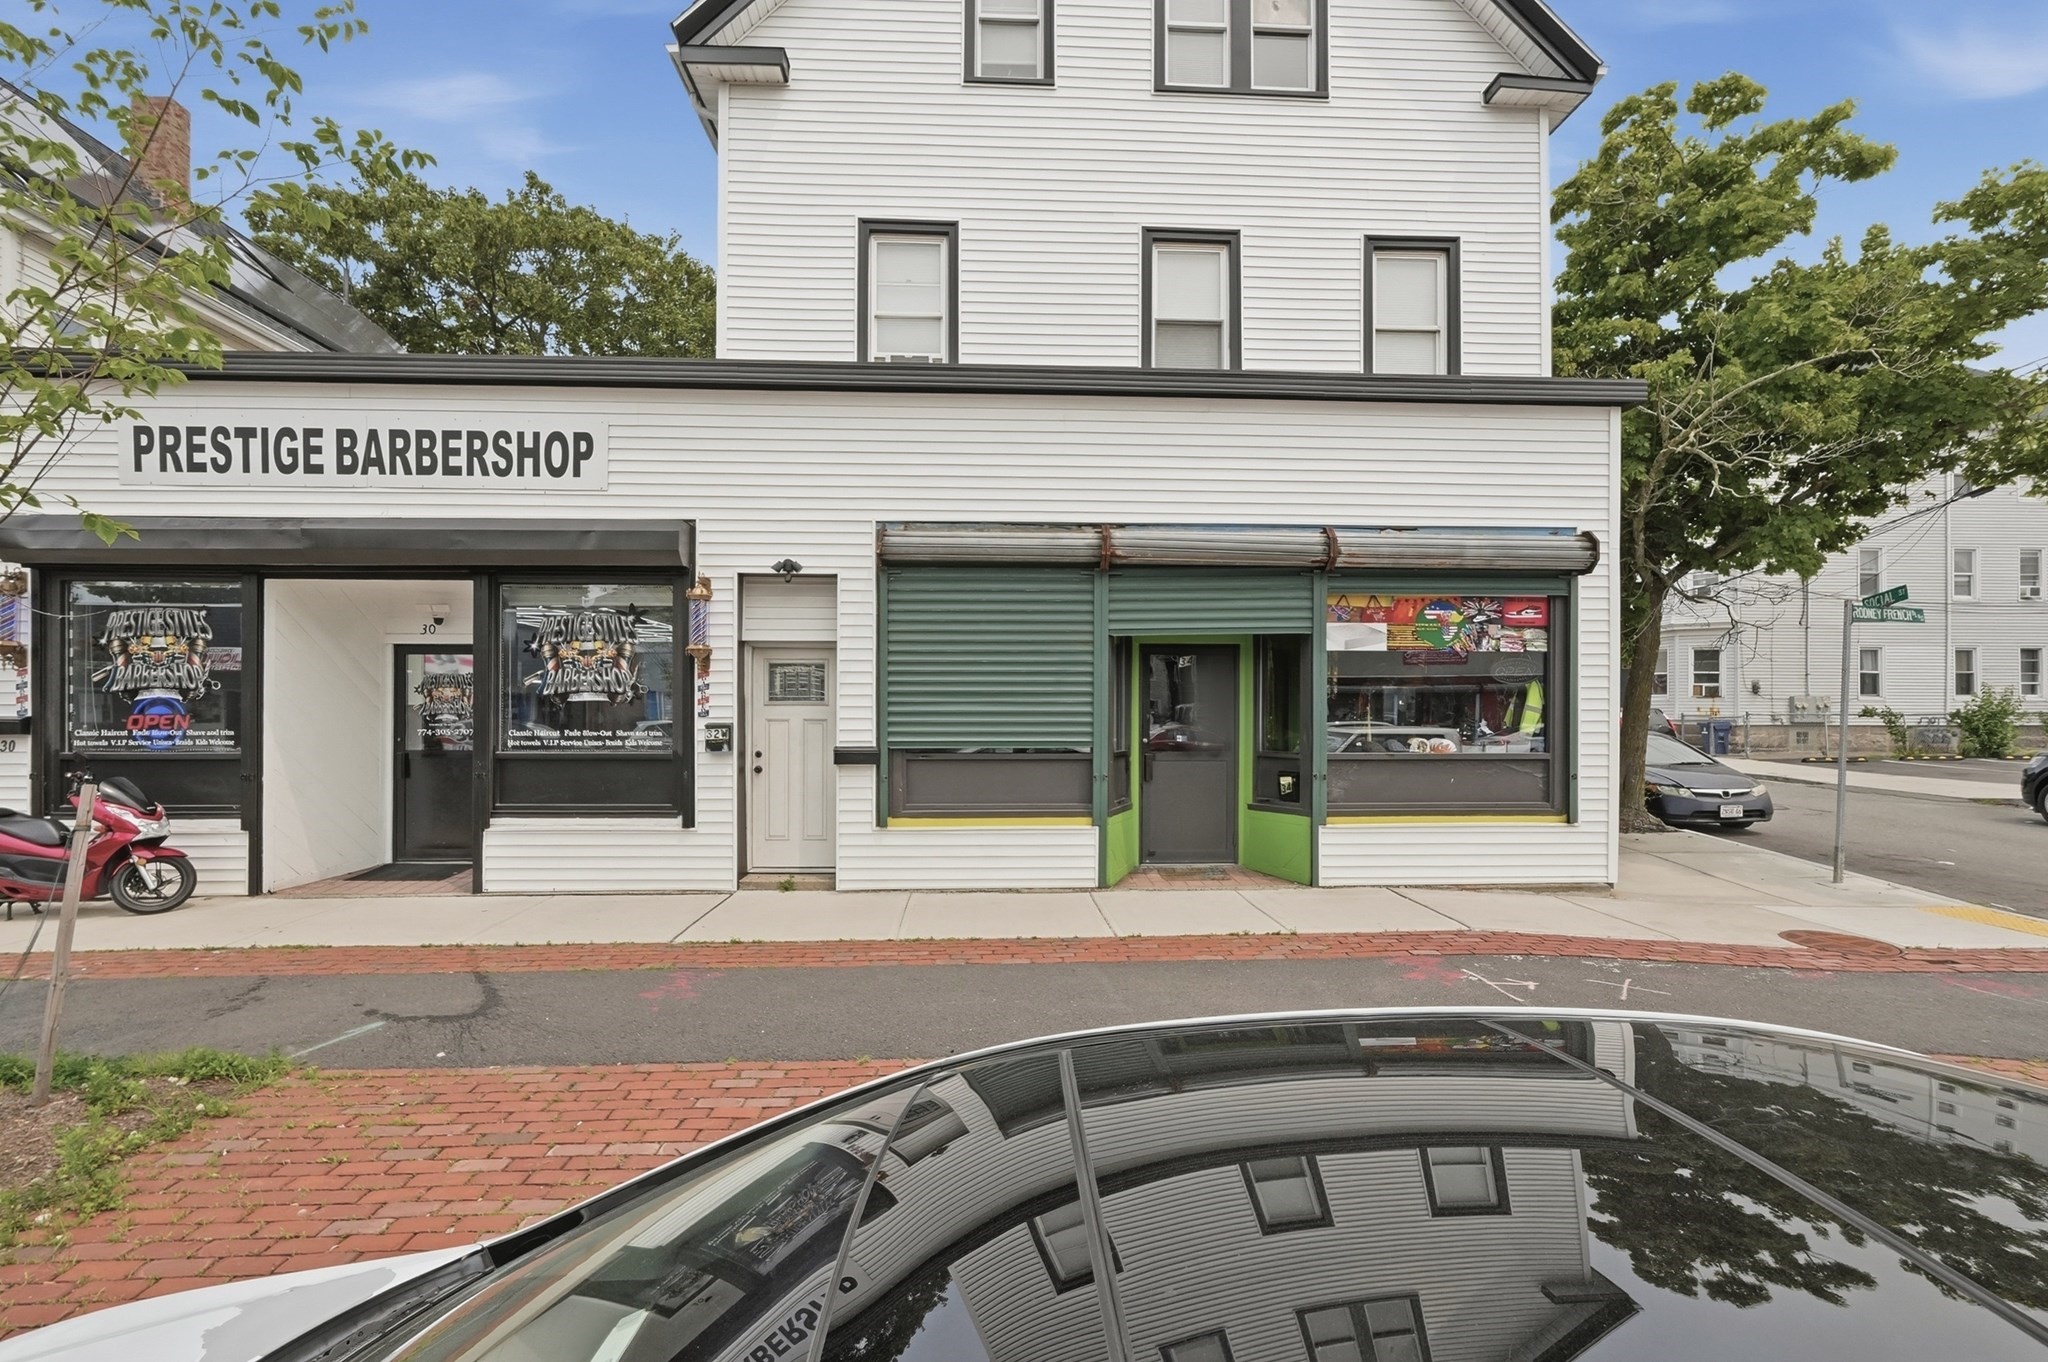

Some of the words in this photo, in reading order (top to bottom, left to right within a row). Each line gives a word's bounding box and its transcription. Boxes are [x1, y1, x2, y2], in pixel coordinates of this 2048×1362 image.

[132, 425, 324, 474] PRESTIGE
[335, 428, 594, 477] BARBERSHOP
[1864, 591, 1896, 608] SOCIAL
[1898, 588, 1906, 597] ST
[1853, 607, 1882, 620] RODNEY
[1883, 608, 1913, 621] FRENCH
[104, 608, 164, 639] PRESTIGE
[164, 608, 213, 640] STYLES
[420, 623, 436, 635] 30
[537, 613, 594, 644] PRESTIGE
[594, 613, 639, 645] STYLES
[1179, 656, 1194, 667] 34
[111, 662, 204, 693] BARBERSHOP
[542, 667, 632, 695] BARBERSHOP
[126, 714, 191, 730] OPEN
[74, 729, 99, 737] Classic
[508, 729, 533, 737] Classic
[534, 729, 560, 737] Haircut
[564, 729, 582, 737] Fade
[0, 740, 16, 753] 30
[73, 739, 86, 747] Hot
[87, 739, 109, 747] towels
[195, 738, 209, 746] Kids
[209, 738, 235, 746] Welcome
[507, 739, 520, 748] Hot
[520, 739, 542, 747] towels
[560, 739, 583, 747] Service
[1280, 781, 1293, 795] 34
